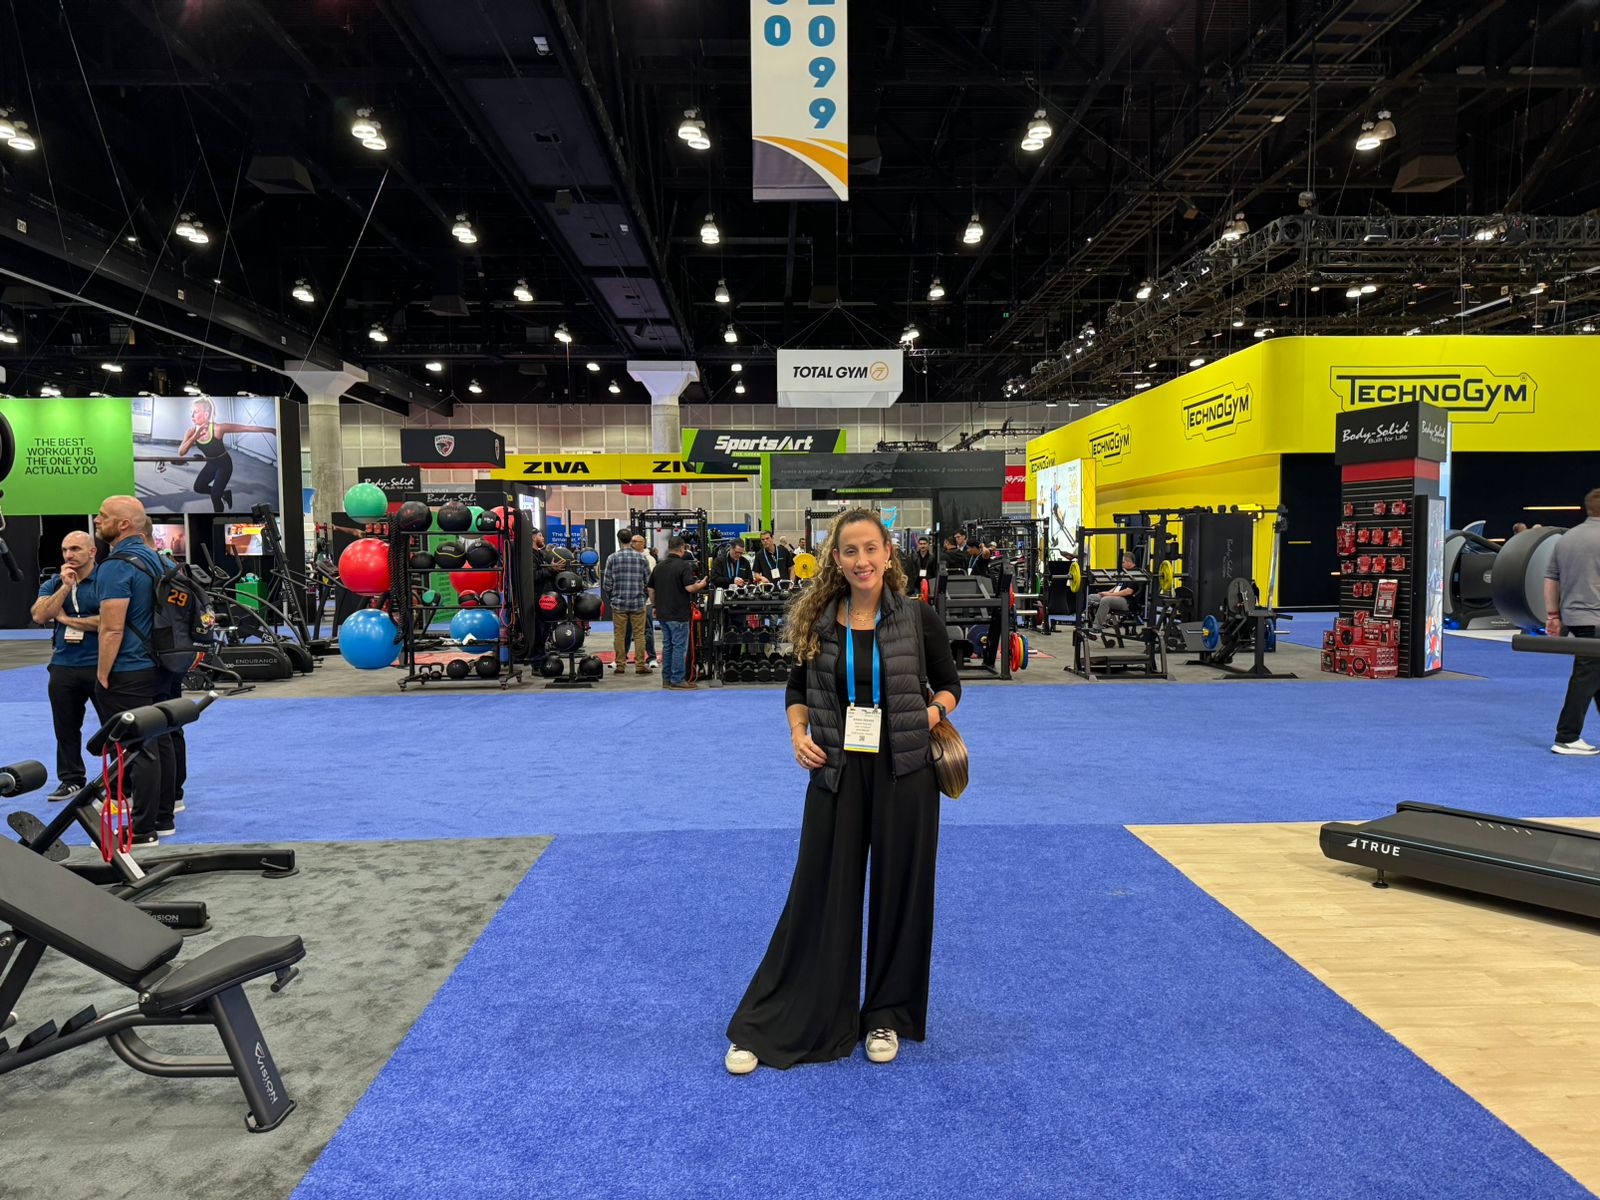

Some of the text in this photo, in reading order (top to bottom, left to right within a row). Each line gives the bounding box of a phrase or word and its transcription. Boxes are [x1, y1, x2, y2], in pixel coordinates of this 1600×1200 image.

[764, 0, 791, 46] 0
[808, 0, 836, 129] 099
[793, 366, 868, 378] TOTAL GYM
[1342, 420, 1409, 444] Body-Solid
[34, 437, 86, 446] THE BEST
[714, 435, 814, 454] SportsArt
[27, 447, 94, 456] WORKOUT IS
[26, 456, 96, 465] THE ONE YOU
[25, 465, 98, 475] ACTUALLY DO
[522, 461, 590, 474] ZIVA
[364, 477, 415, 488] Bdy-Solid
[427, 493, 477, 502] Body-Soli
[167, 589, 188, 607] 29
[1360, 839, 1401, 857] TRUE
